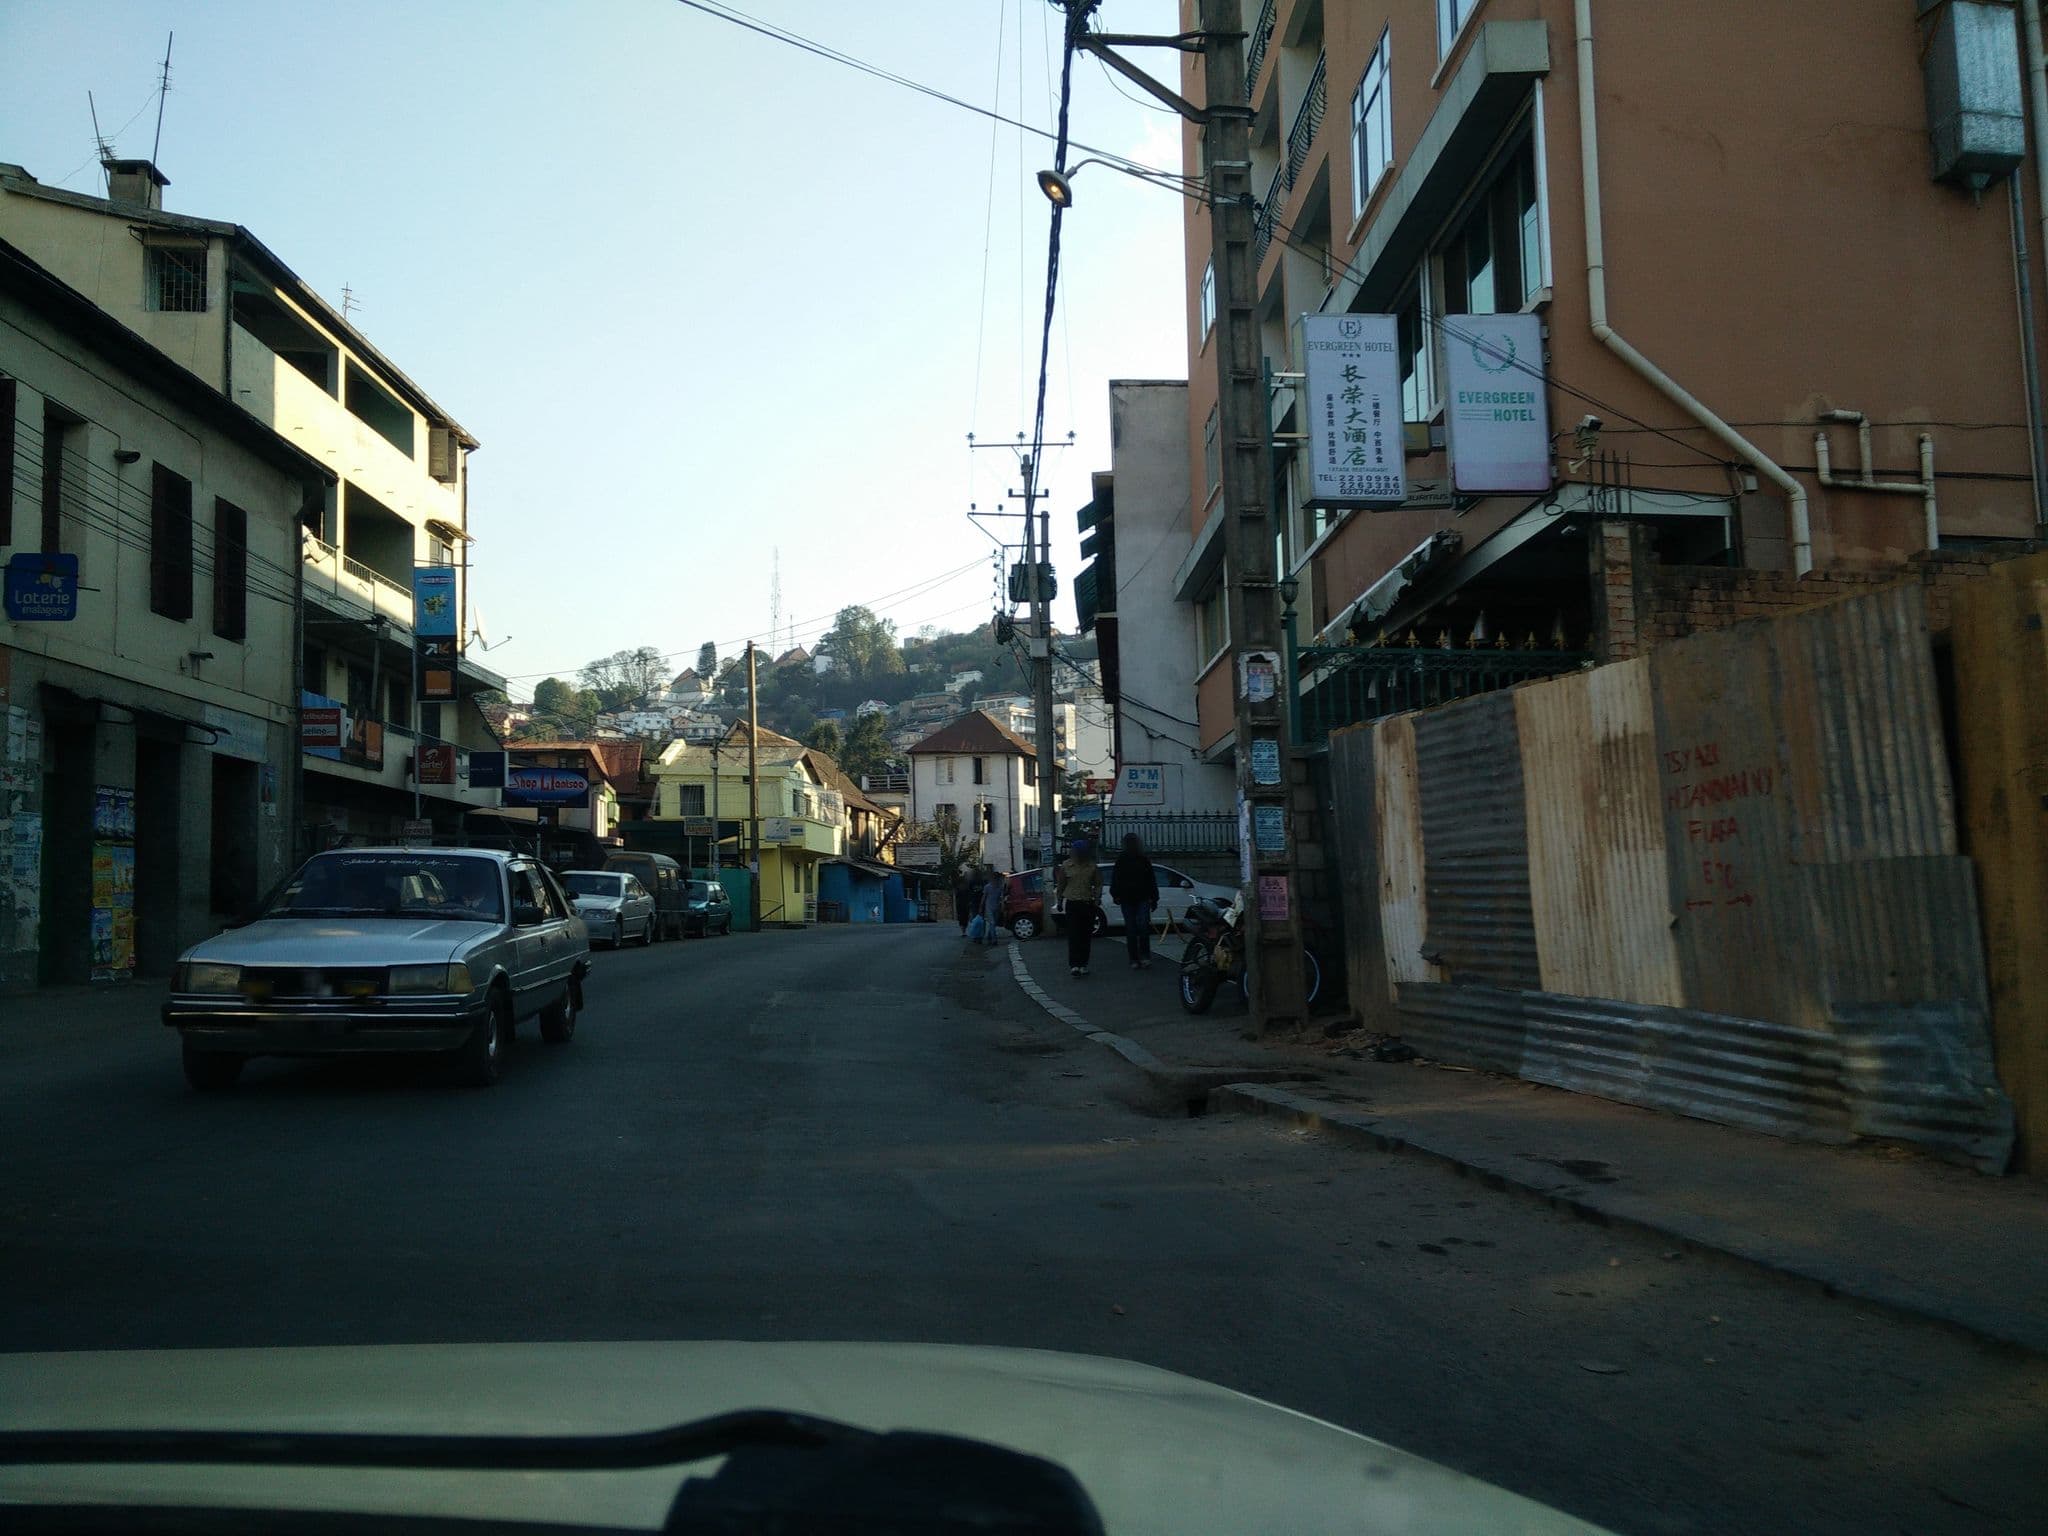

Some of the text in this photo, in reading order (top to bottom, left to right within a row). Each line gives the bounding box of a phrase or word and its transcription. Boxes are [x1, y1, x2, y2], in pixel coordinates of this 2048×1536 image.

[1307, 341, 1395, 353] EVERGREEN HOTEL
[1458, 391, 1535, 405] EVERGREEN
[1339, 364, 1368, 467] 长荣大酒店
[1493, 409, 1536, 422] HOTEL
[1318, 474, 1337, 482] TEL:
[14, 590, 70, 605] Loterie
[22, 604, 70, 617] malagasy
[1127, 781, 1159, 790] CYBER
